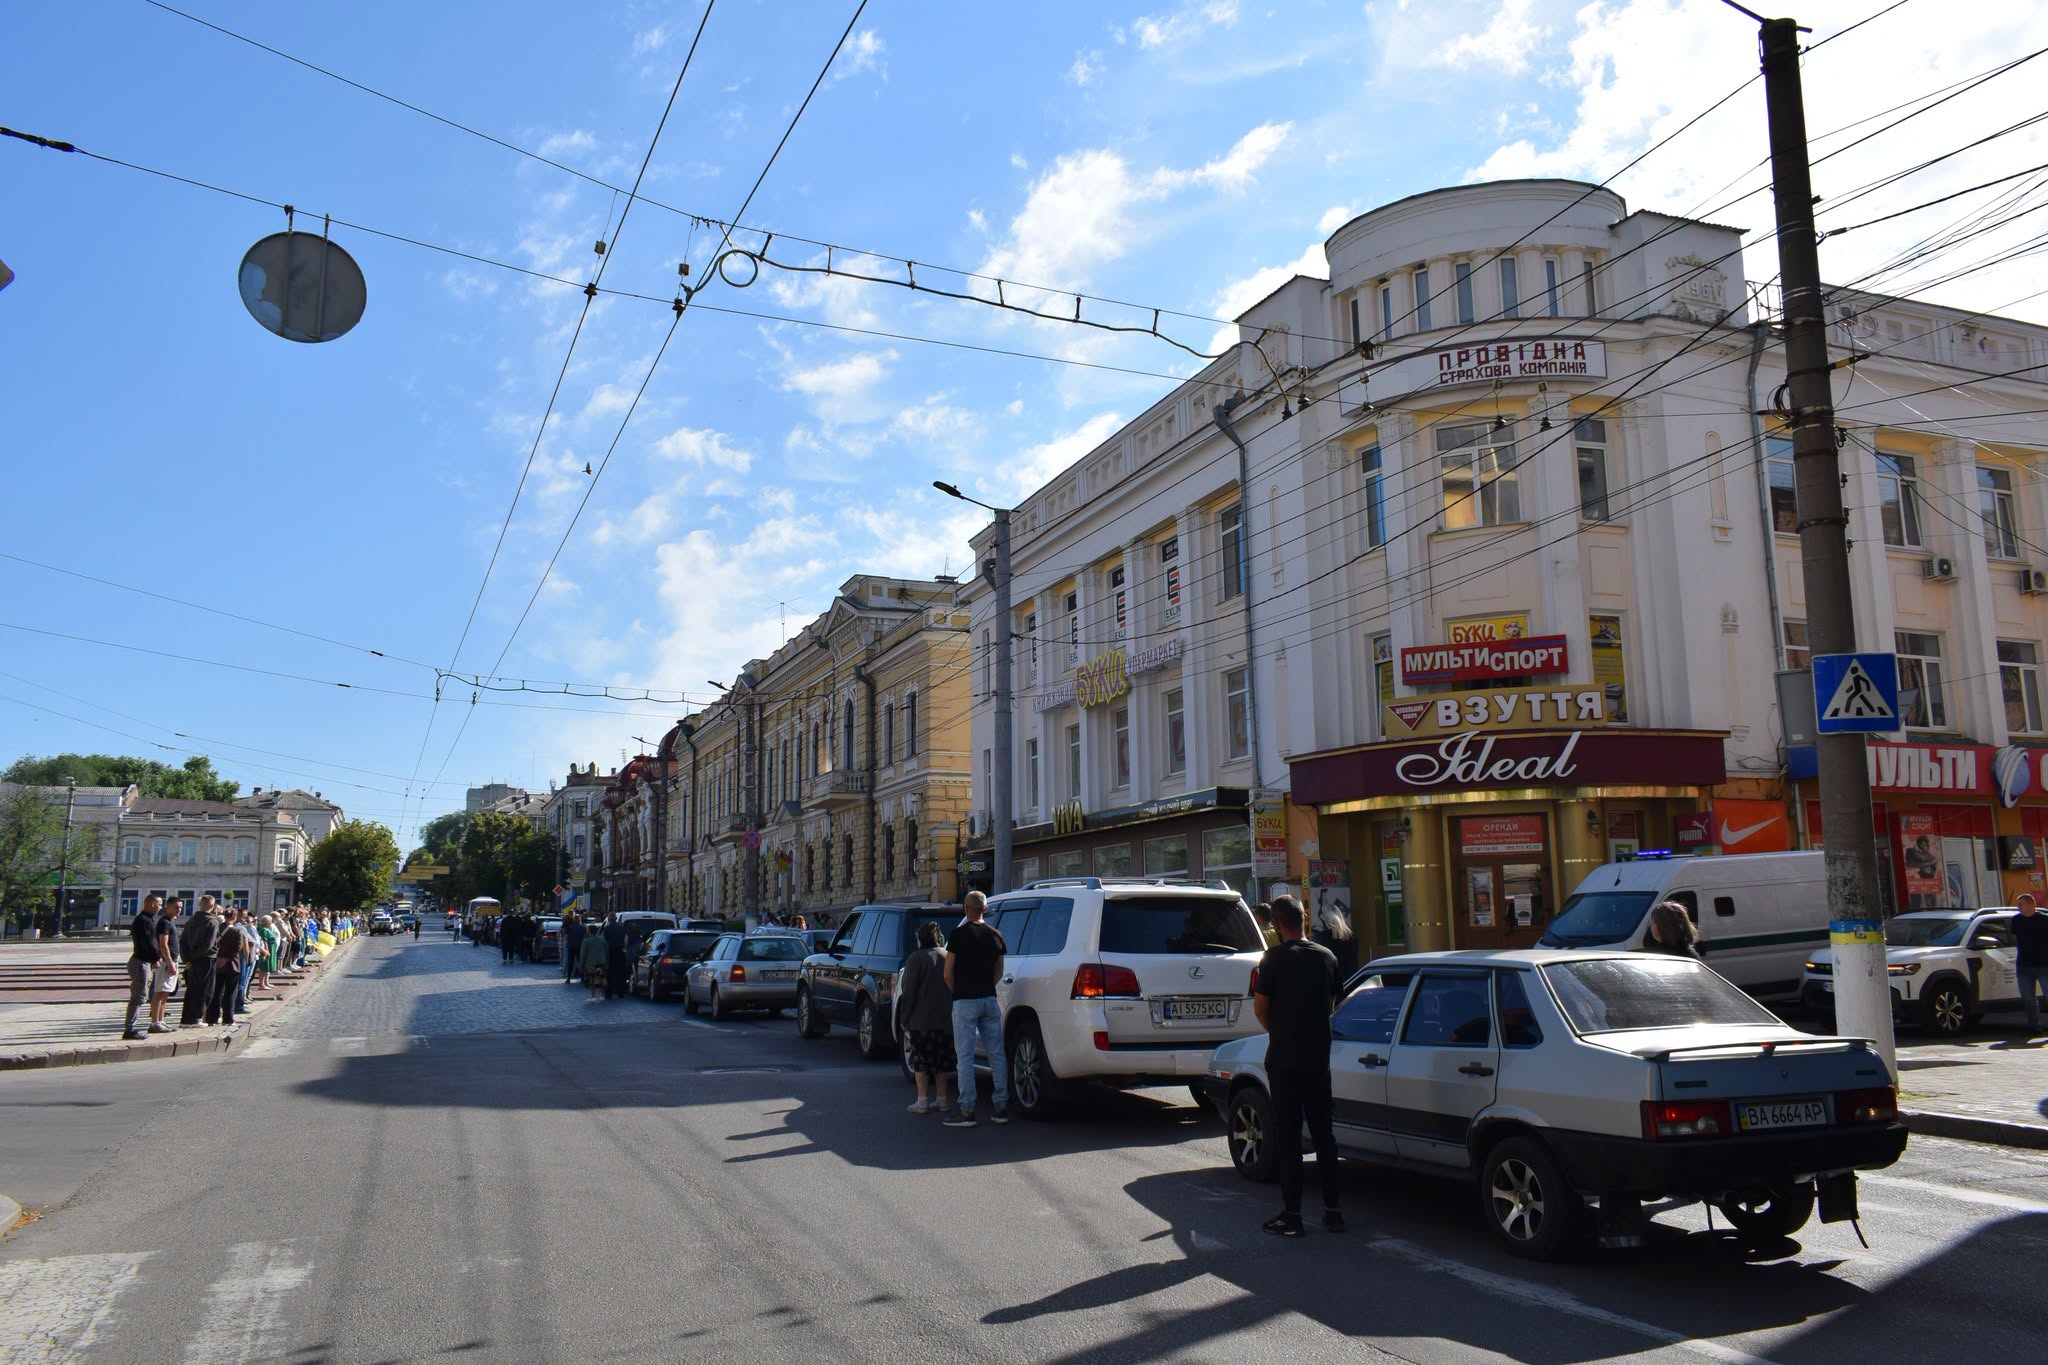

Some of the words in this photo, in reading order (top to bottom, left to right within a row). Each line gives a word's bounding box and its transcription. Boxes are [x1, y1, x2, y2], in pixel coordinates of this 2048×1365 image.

[1439, 342, 1586, 371] ПРОВІДНА
[1440, 364, 1512, 385] СТРАХОВА
[1519, 361, 1587, 375] КОМПАНІЯ
[1452, 623, 1496, 644] БУКИ
[1405, 647, 1563, 673] МУЛЬТИСПОРТ
[1076, 651, 1127, 707] БУКИ
[1124, 638, 1179, 677] СУПЕРМАРКЕТ
[1436, 691, 1603, 728] ВЗУТТЯ
[1396, 730, 1582, 786] Ideal
[1256, 817, 1282, 829] БУКИ
[1483, 823, 1518, 832] ОРЕНДИ
[1679, 829, 1702, 841] PUMA
[2010, 857, 2033, 865] adidas
[1172, 1004, 1182, 1015] AI
[1186, 1003, 1206, 1015] 5575
[1208, 1003, 1222, 1014] KC
[1748, 1107, 1769, 1126] BA
[1772, 1105, 1802, 1124] 6664
[1805, 1103, 1823, 1122] AP
